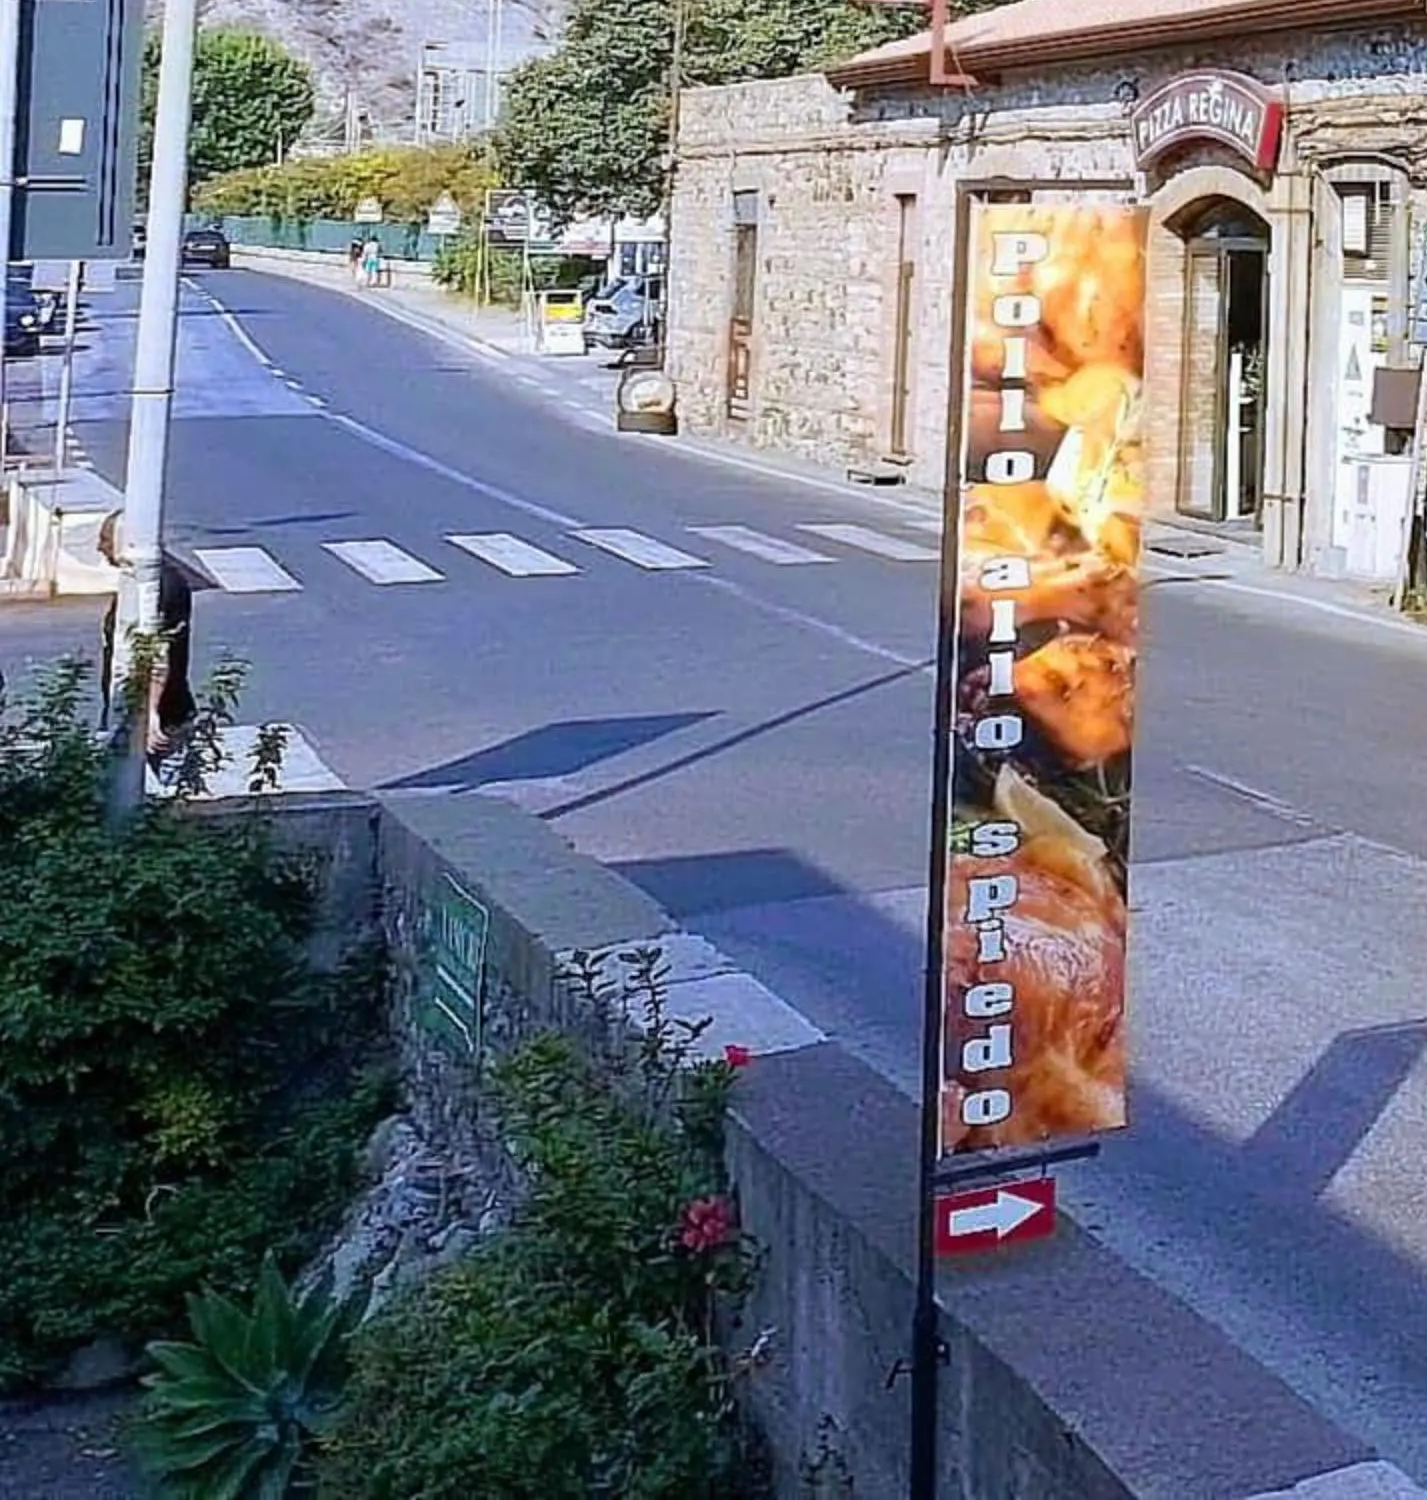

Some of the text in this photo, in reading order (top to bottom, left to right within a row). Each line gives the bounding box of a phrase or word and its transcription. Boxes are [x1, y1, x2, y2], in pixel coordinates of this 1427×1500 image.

[1138, 90, 1255, 150] PIZZA REGINA
[959, 231, 1049, 1125] Pollo allo spiedo
